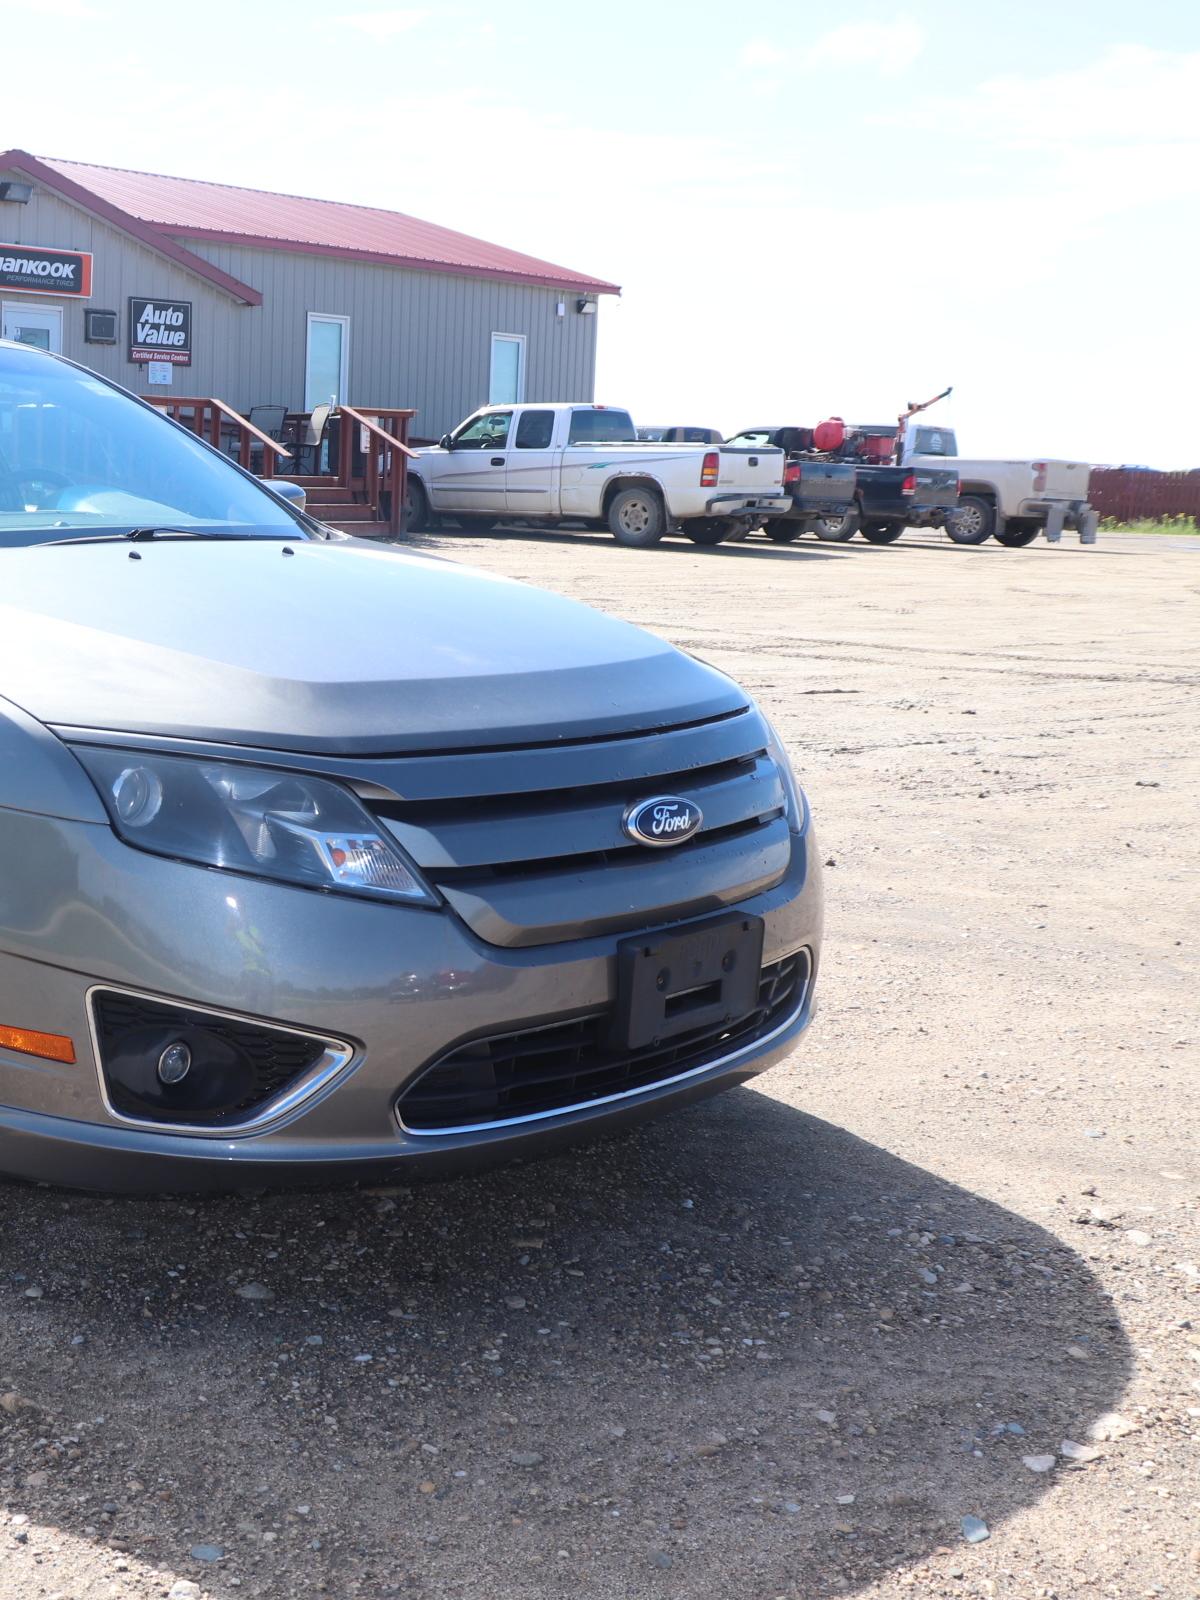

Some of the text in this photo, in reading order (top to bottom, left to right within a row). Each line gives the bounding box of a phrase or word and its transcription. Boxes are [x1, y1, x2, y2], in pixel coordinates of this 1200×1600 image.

[6, 274, 75, 287] PERFORMANCE TIRES
[139, 303, 184, 326] Auto
[136, 323, 186, 346] Value
[132, 351, 154, 359] Certified
[153, 352, 171, 360] Service
[652, 804, 691, 834] Ford
